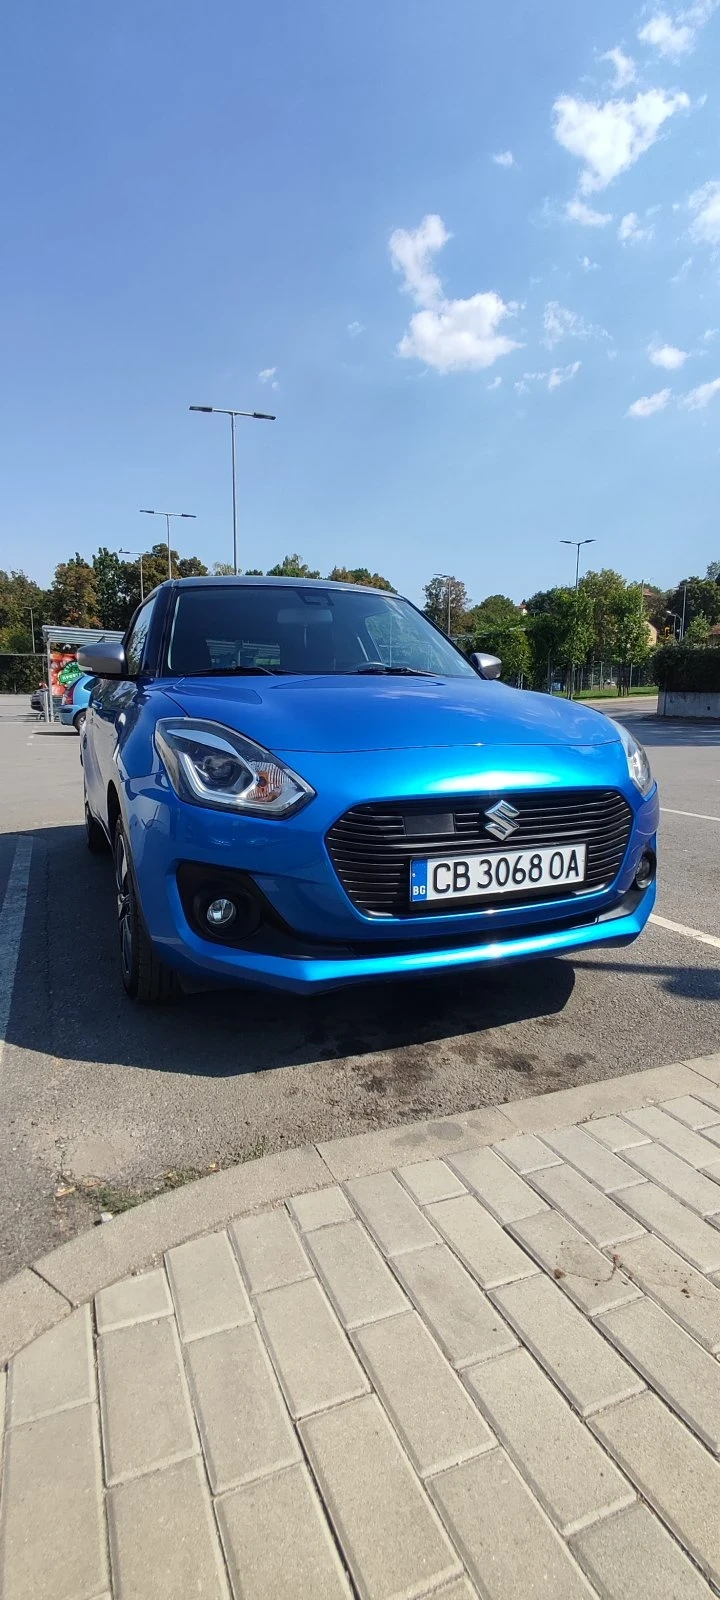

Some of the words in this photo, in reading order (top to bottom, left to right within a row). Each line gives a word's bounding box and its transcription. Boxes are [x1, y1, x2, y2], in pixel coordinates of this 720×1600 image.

[432, 861, 471, 893] CB
[477, 853, 543, 889] 3068
[549, 849, 579, 879] OA
[412, 885, 426, 895] BG
